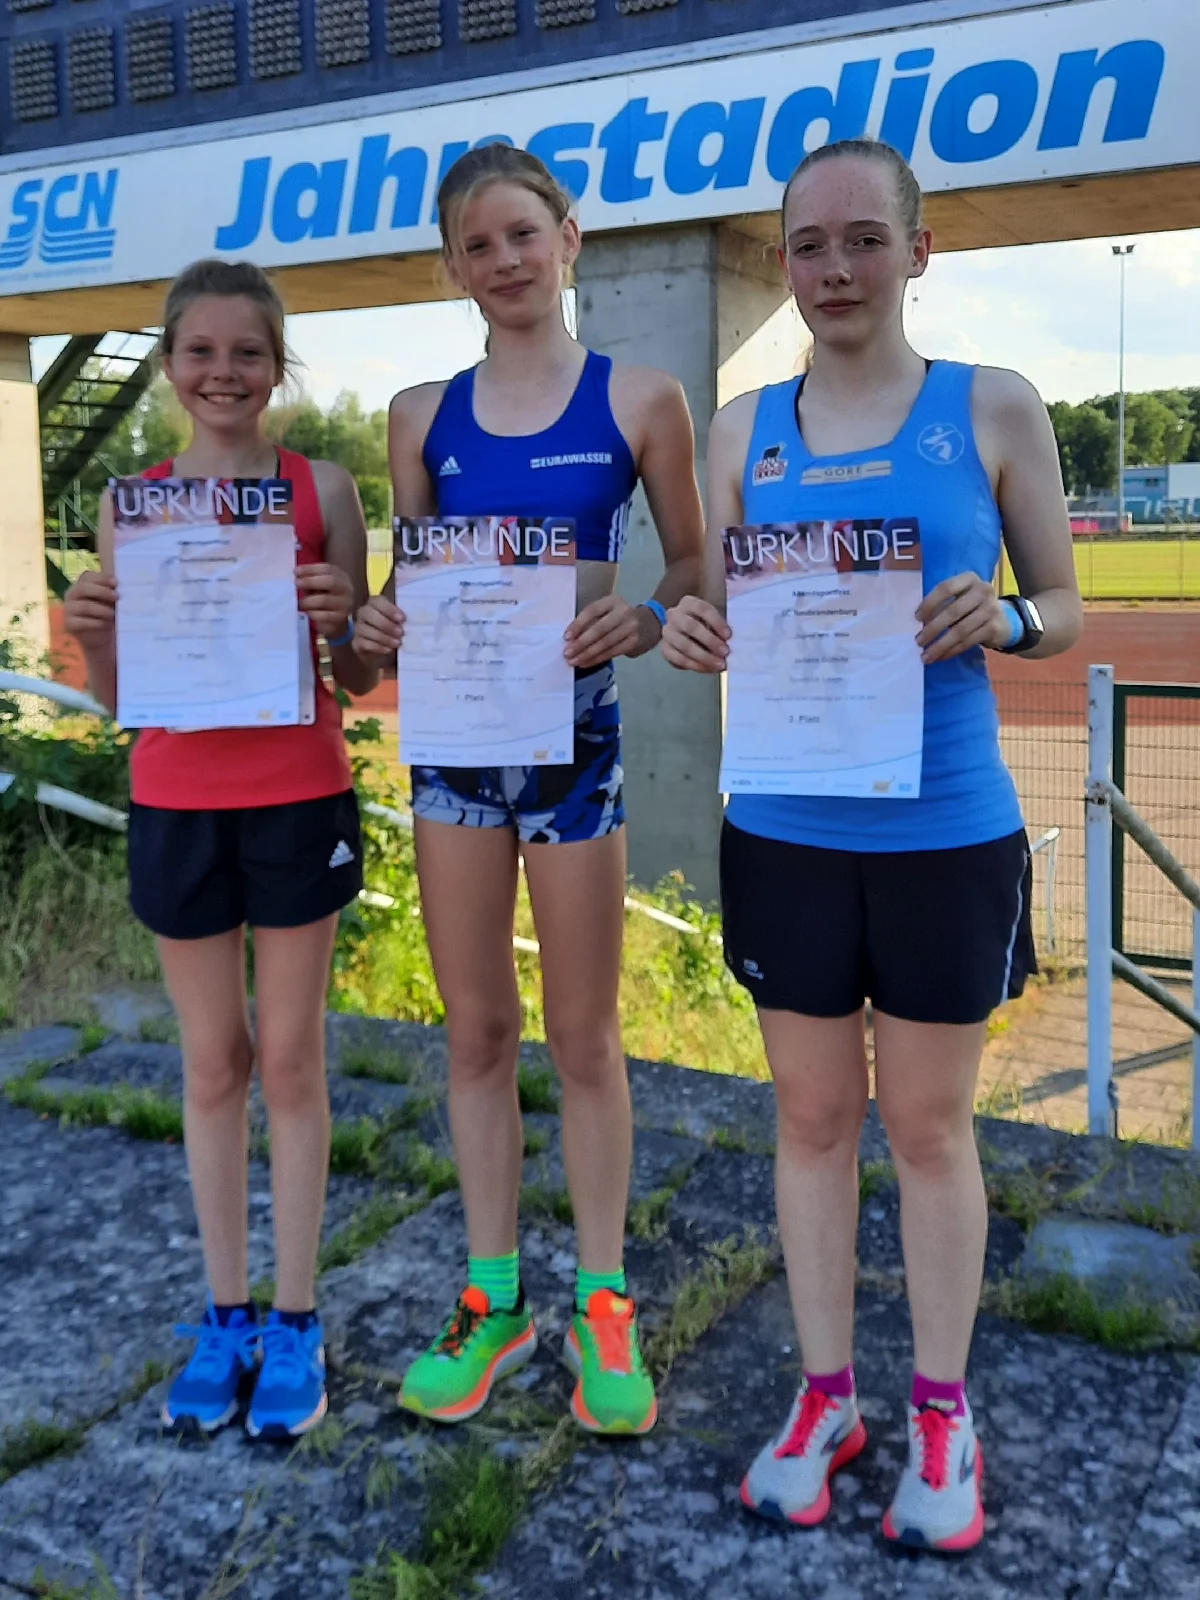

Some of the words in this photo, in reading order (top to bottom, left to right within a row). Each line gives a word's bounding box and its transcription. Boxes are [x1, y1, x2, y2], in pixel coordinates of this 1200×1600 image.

[214, 38, 1166, 252] Jahstadion
[8, 168, 118, 239] SCN
[117, 486, 288, 517] URKUNDE
[402, 526, 569, 558] URKUNDE
[730, 528, 915, 566] URKUNDE
